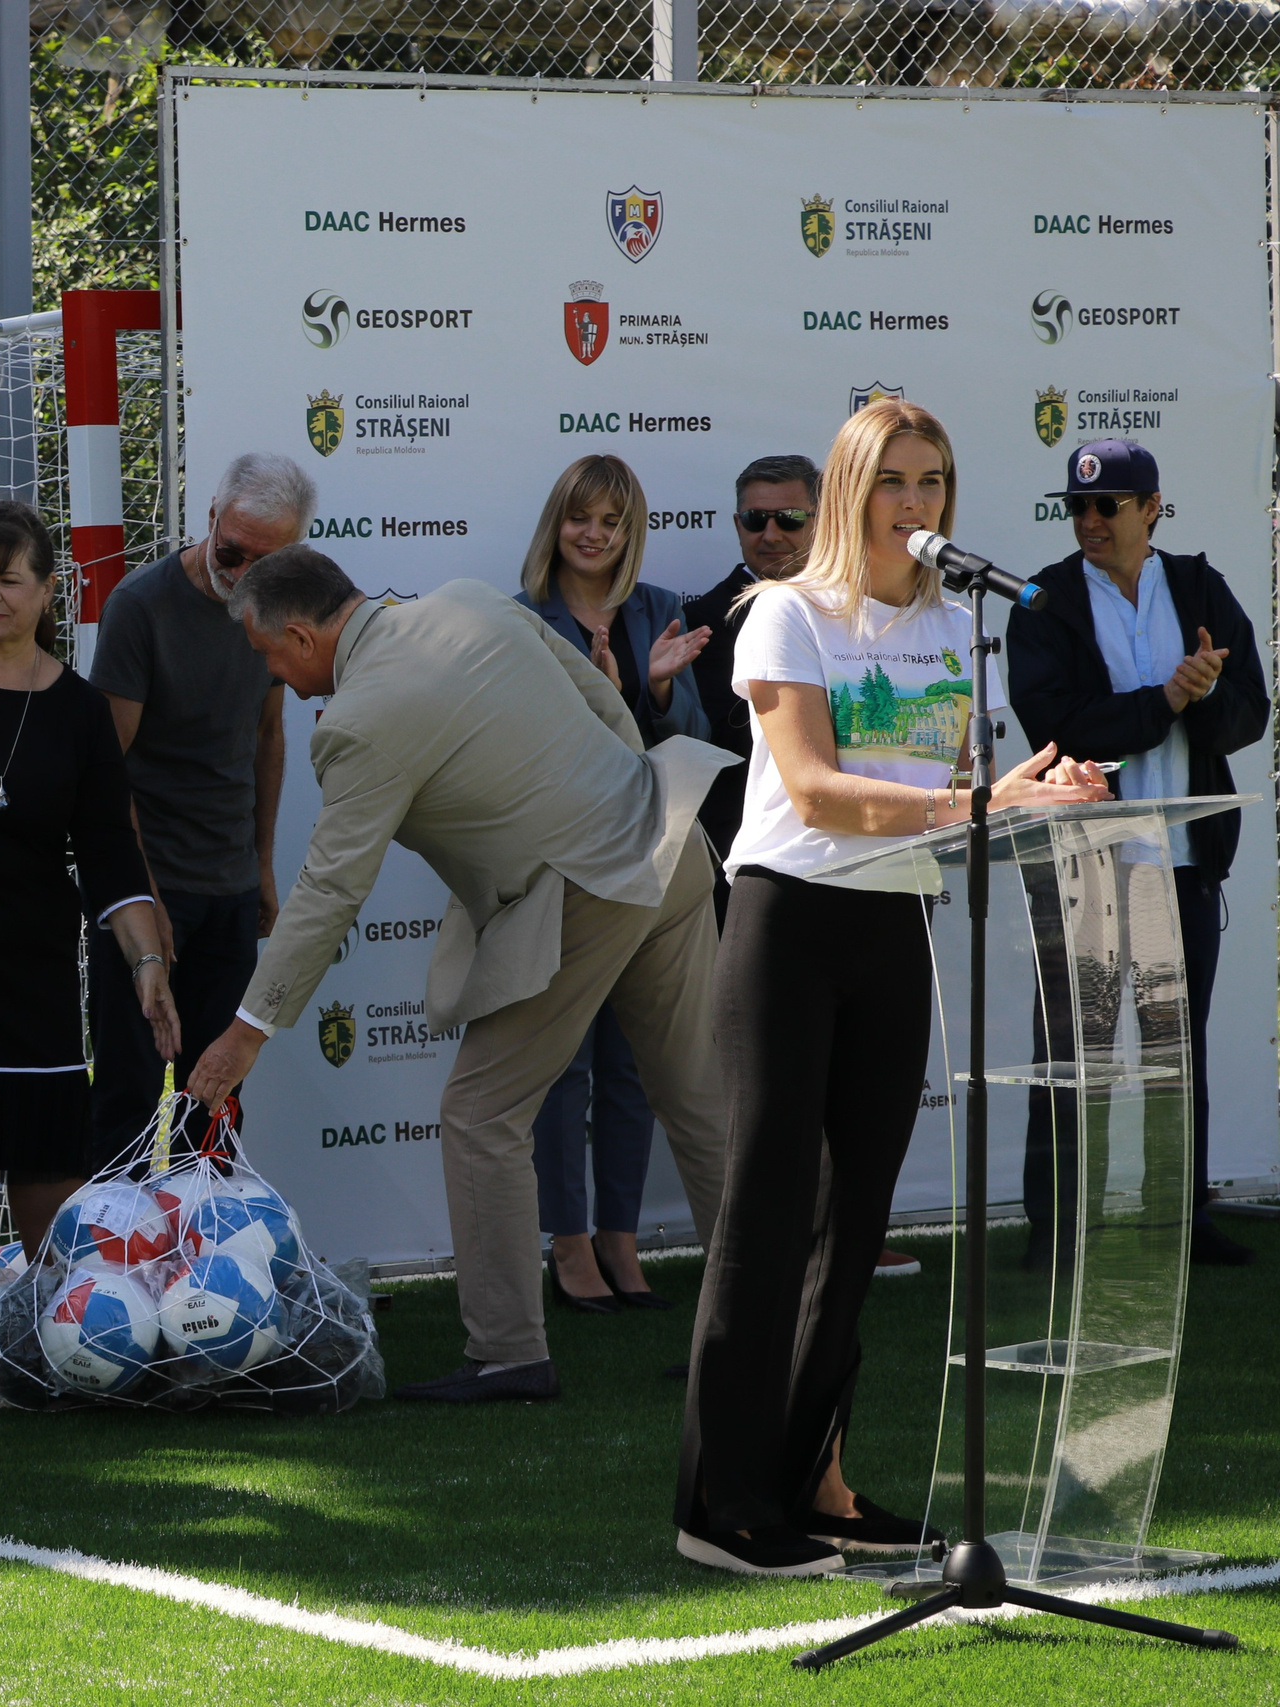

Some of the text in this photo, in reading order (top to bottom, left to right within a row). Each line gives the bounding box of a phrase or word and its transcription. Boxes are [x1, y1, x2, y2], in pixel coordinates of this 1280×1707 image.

[615, 204, 655, 217] FMF
[845, 199, 948, 213] Consiliul Raional
[305, 211, 465, 232] DAAC Hermes
[1035, 215, 1173, 234] DAAC Hermes
[846, 219, 931, 246] STRĂȘENI
[846, 248, 909, 258] Republica Moldova
[357, 310, 472, 328] GEOSPORT
[620, 315, 681, 326] PRIMARIA
[804, 311, 948, 330] DAAC Hermes
[1079, 308, 1180, 325] GEOSPORT
[646, 330, 708, 348] STRĂȘENI
[356, 394, 468, 409] Consiliul Raional
[1078, 388, 1178, 403] Consiliul Raional
[356, 415, 449, 443] STRĂȘENI
[560, 413, 711, 433] DAAC Hermes
[1078, 408, 1160, 434] STRĂȘENI
[357, 446, 392, 456] Republica
[309, 517, 467, 538] DAAC Hermes
[649, 511, 716, 529] SPORT
[867, 652, 901, 661] Raional
[903, 653, 942, 666] STRĂȘEN
[365, 920, 442, 942] GEOSP
[367, 1000, 424, 1018] Consiliul
[368, 1051, 436, 1064] Republica Moldova
[919, 1093, 957, 1111] ĂȘENI
[322, 1122, 441, 1148] DAAC Her
[181, 1314, 220, 1335] gala
